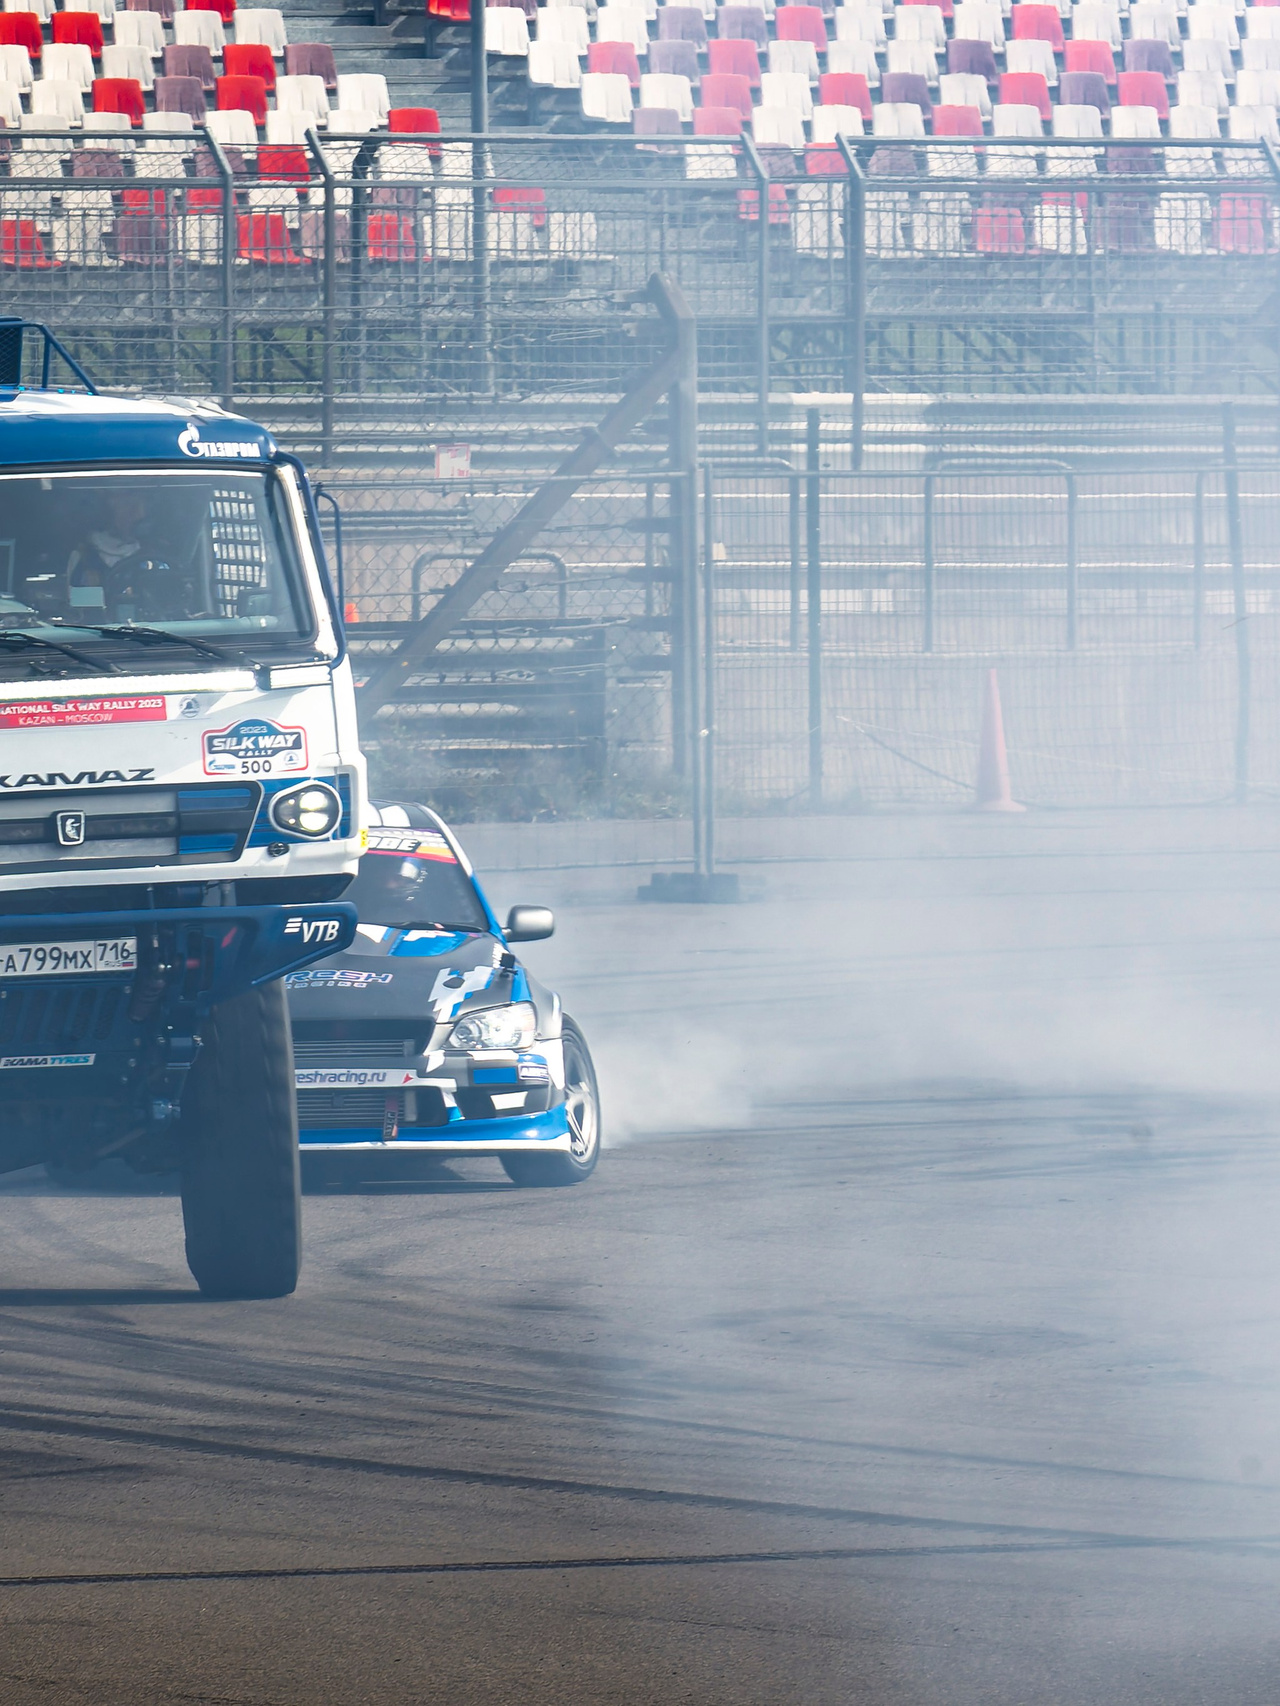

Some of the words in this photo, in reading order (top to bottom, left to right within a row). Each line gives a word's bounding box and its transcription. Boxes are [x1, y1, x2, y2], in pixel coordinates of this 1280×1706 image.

[52, 702, 75, 713] SILK
[77, 701, 102, 712] WAY
[103, 700, 136, 711] RALLY
[137, 698, 163, 709] 2023
[18, 715, 56, 725] KAZAN
[66, 713, 113, 724] MOSCOW
[239, 725, 268, 734] 2023
[211, 736, 257, 751] SILK
[258, 734, 300, 748] WAY
[238, 749, 274, 757] RALLY
[241, 760, 272, 774] 500
[302, 920, 340, 943] VTB
[98, 941, 131, 962] 716
[104, 960, 122, 968] RUS
[295, 1070, 387, 1085] reshracing.ru
